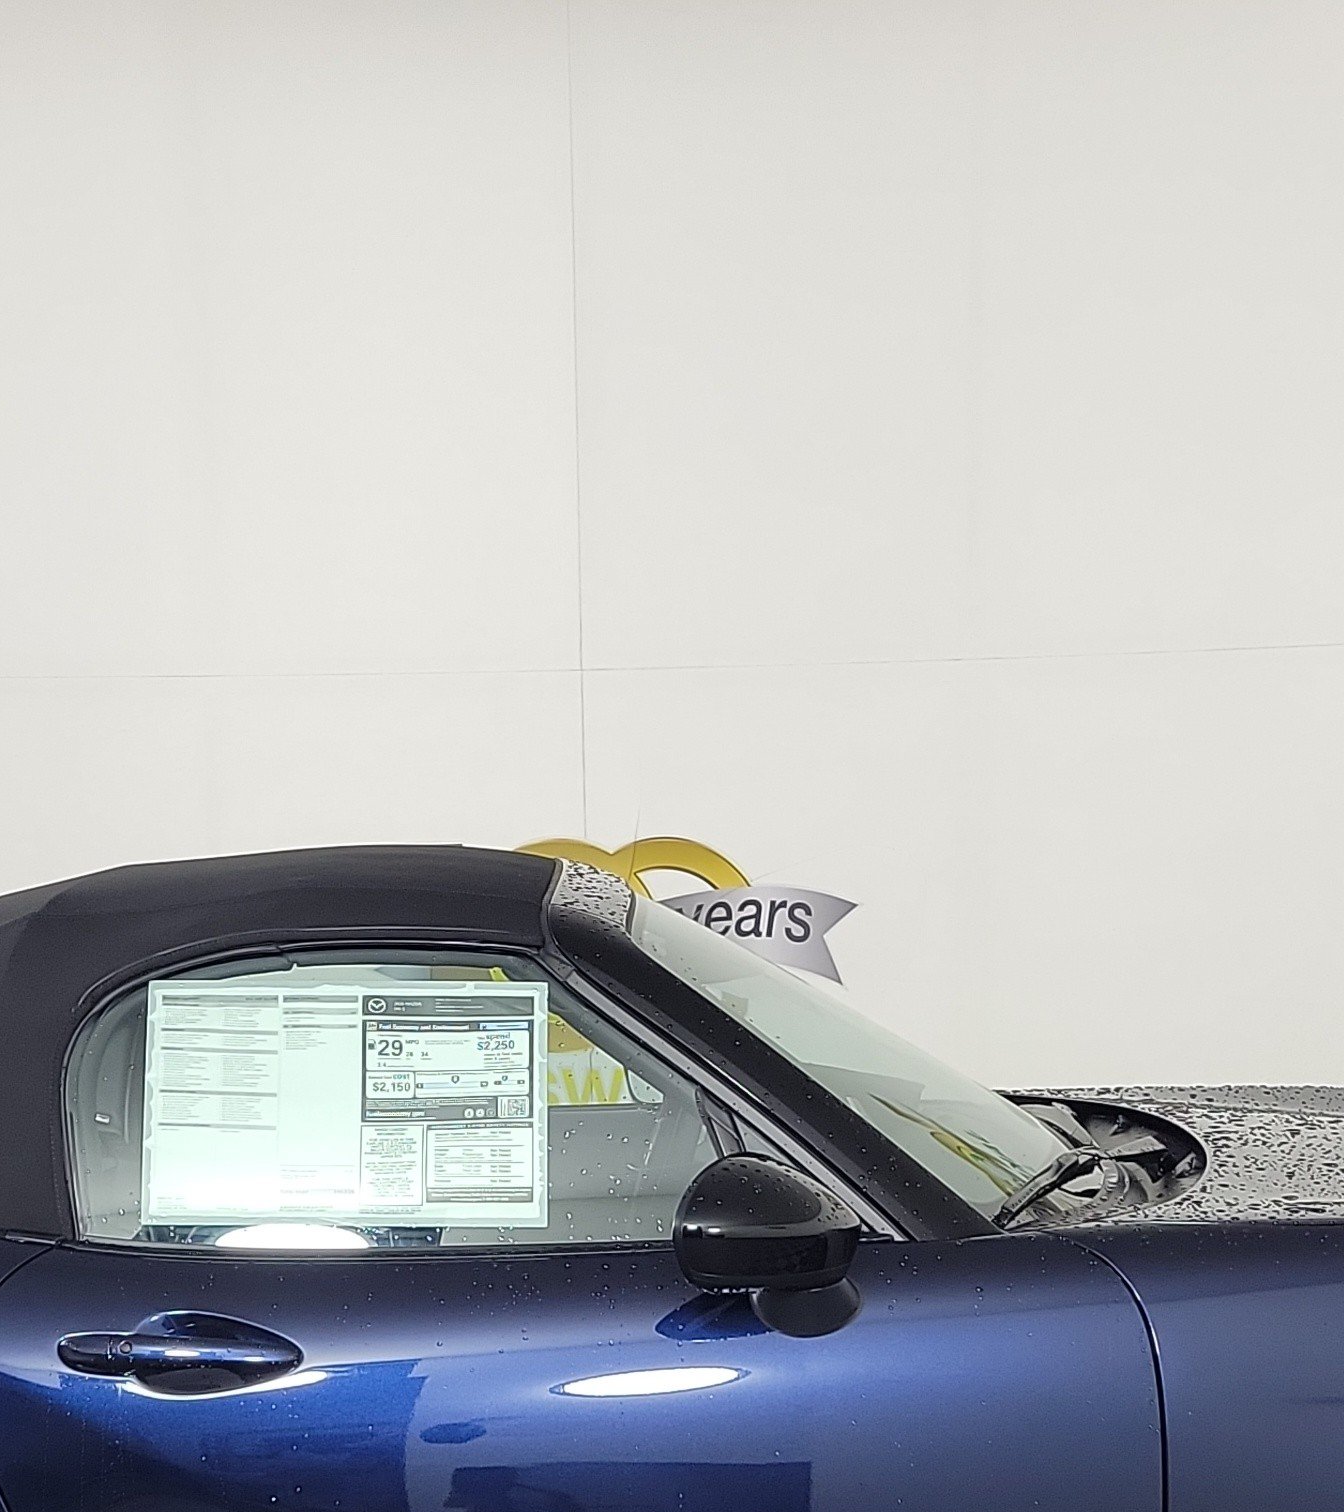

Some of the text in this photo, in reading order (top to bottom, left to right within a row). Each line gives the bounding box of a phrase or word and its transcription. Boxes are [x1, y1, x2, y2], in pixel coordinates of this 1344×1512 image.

[377, 1039, 404, 1057] 29
[476, 1039, 515, 1051] $2,250
[372, 1081, 411, 1093] $2,150
